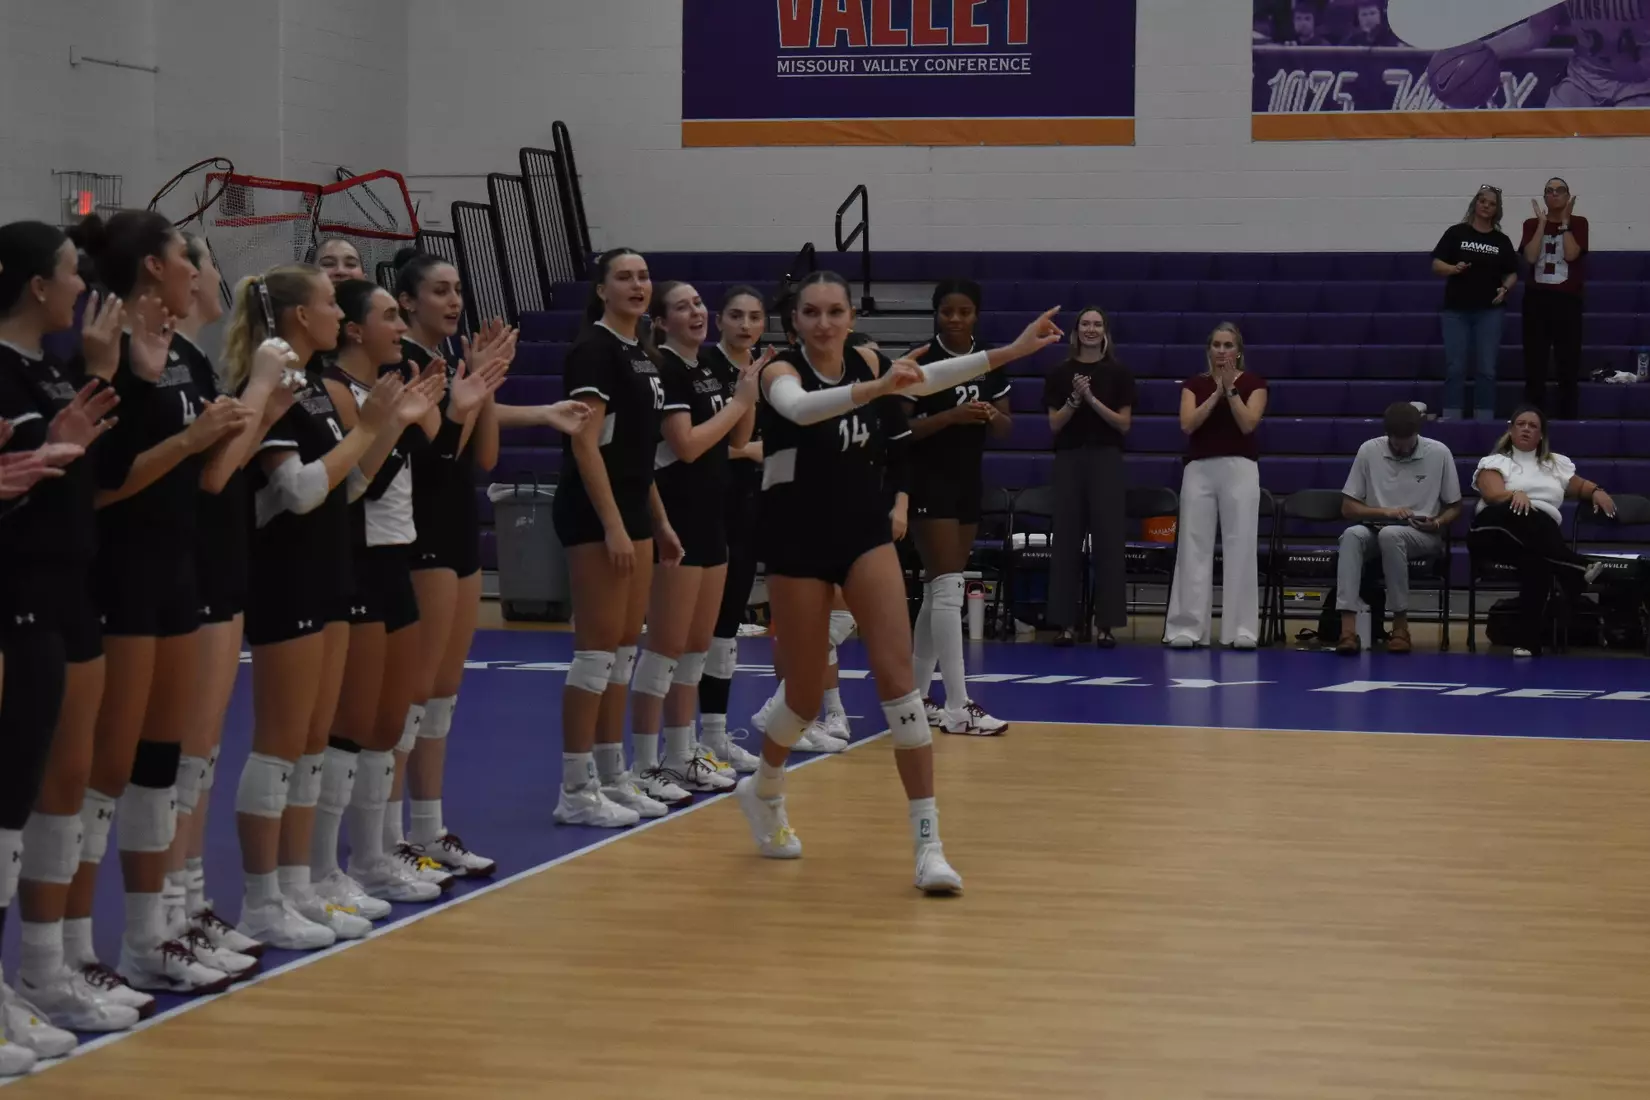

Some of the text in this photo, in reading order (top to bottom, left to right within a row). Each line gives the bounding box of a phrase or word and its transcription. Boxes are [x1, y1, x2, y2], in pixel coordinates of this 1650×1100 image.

[777, 57, 1031, 73] MISSOURI VALLEY CONFERENCE
[1460, 240, 1500, 254] DAWGS
[649, 376, 666, 411] 15
[838, 414, 871, 453] 14
